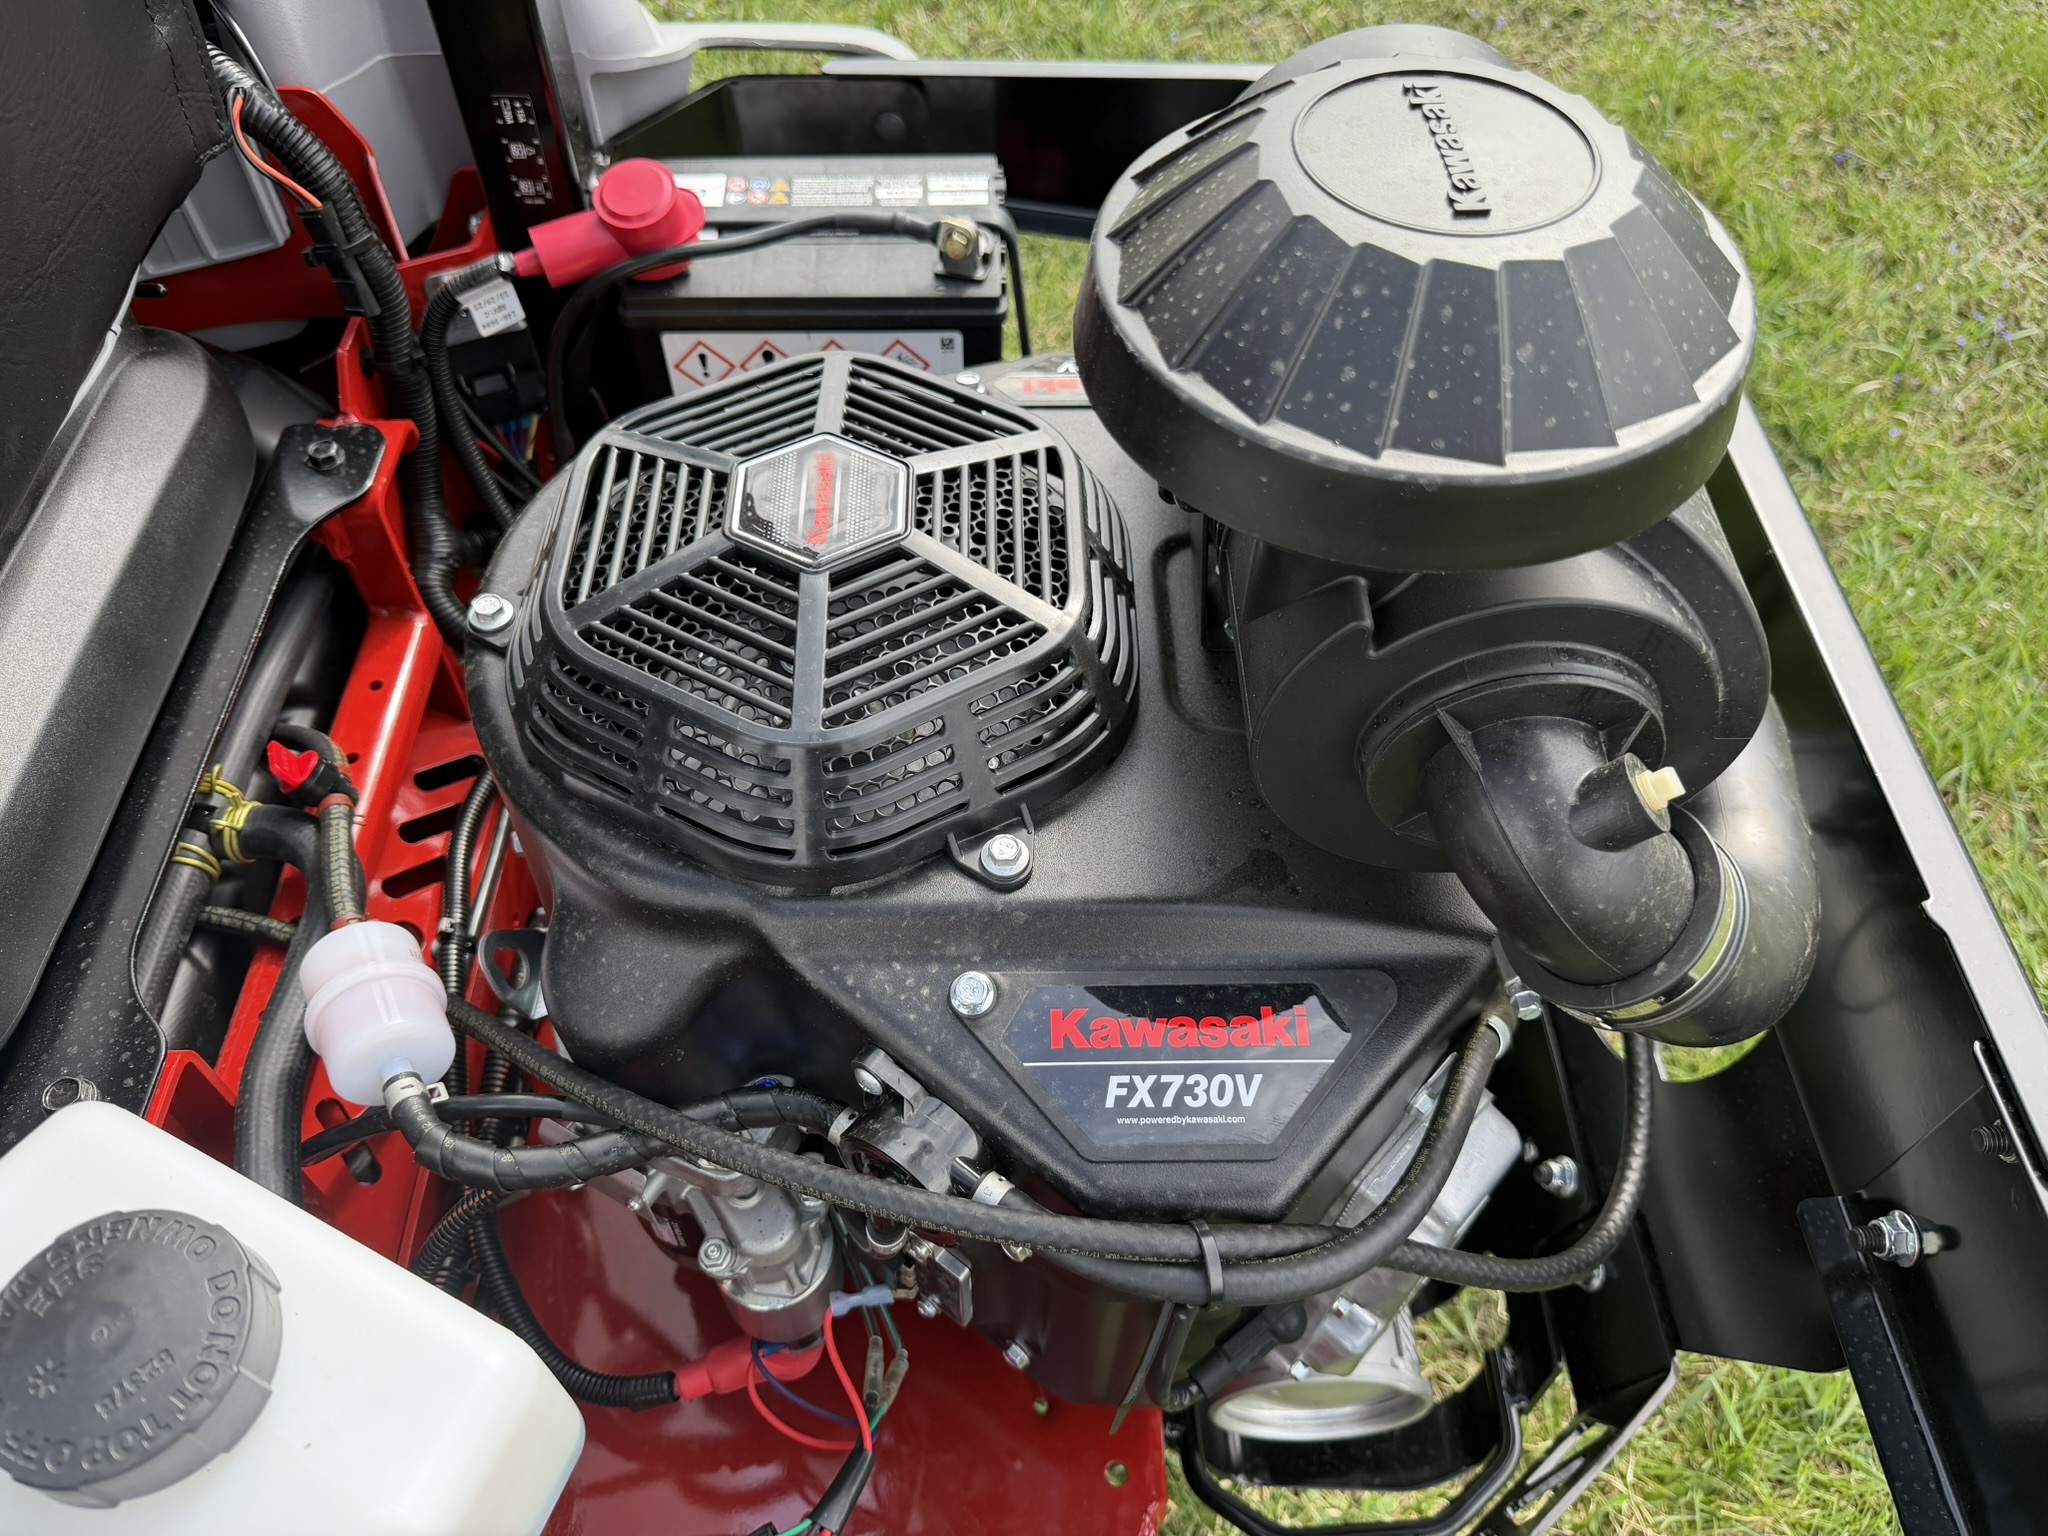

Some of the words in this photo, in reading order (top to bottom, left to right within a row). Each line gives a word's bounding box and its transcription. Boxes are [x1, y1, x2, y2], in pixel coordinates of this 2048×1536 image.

[1402, 83, 1492, 216] Kawasaki
[807, 453, 836, 546] Kawasaki
[1050, 1005, 1311, 1050] Kawasaki
[1104, 1073, 1263, 1109] FX730V
[1116, 1114, 1246, 1127] www.poweredbykawasaki.com
[205, 1270, 241, 1325] DO
[168, 1331, 236, 1422] NOT
[81, 1413, 173, 1472] TOP
